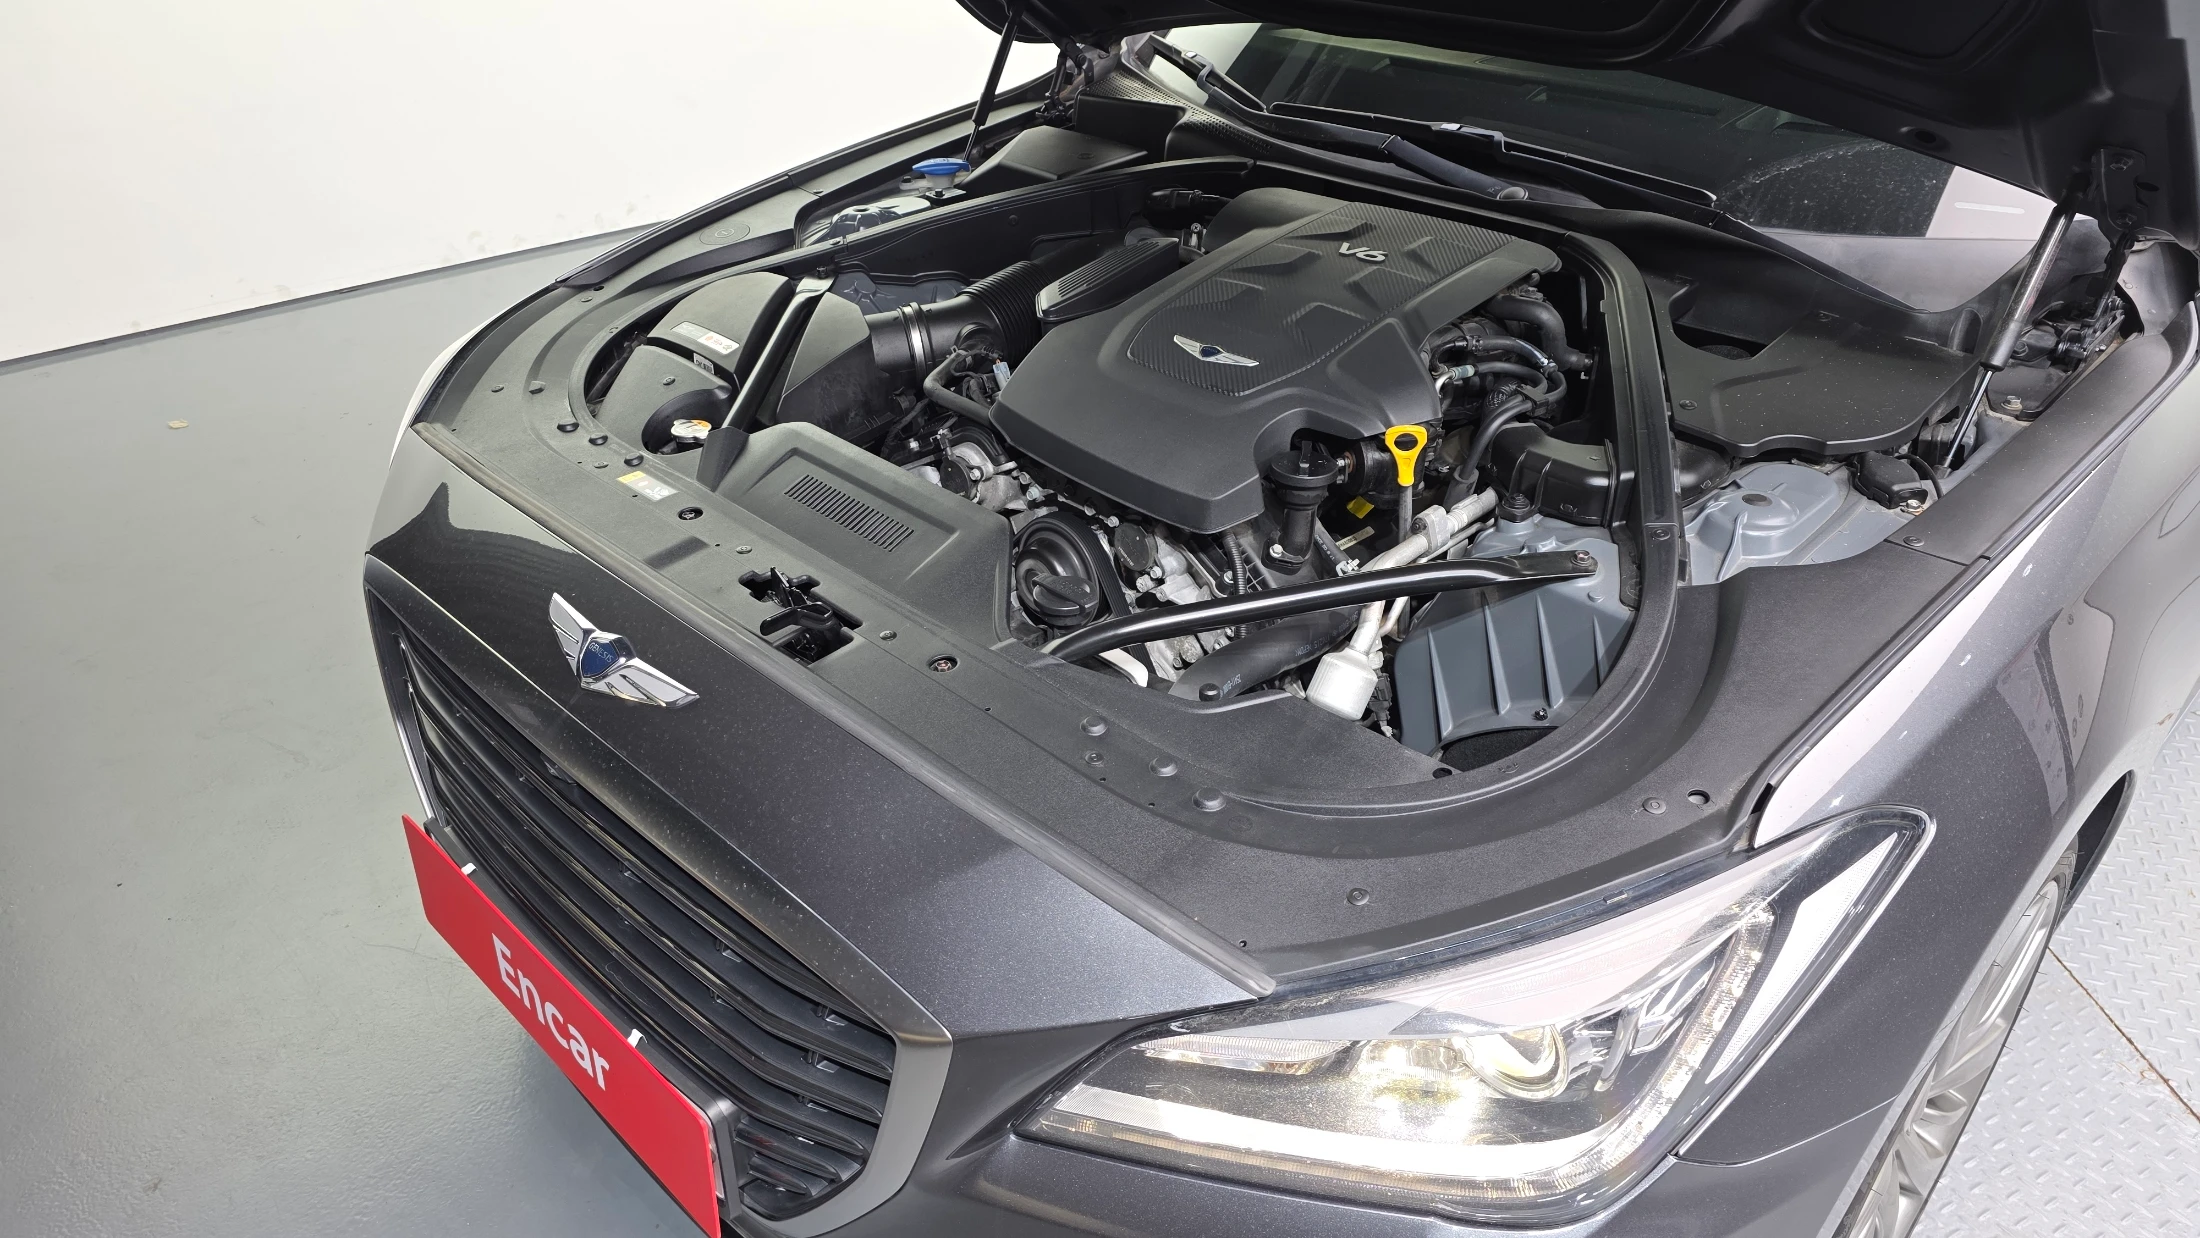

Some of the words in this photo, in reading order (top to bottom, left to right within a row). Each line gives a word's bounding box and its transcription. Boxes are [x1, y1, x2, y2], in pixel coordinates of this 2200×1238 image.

[1339, 242, 1388, 262] V6
[588, 642, 614, 663] GENESIS
[491, 932, 610, 1092] Encar
